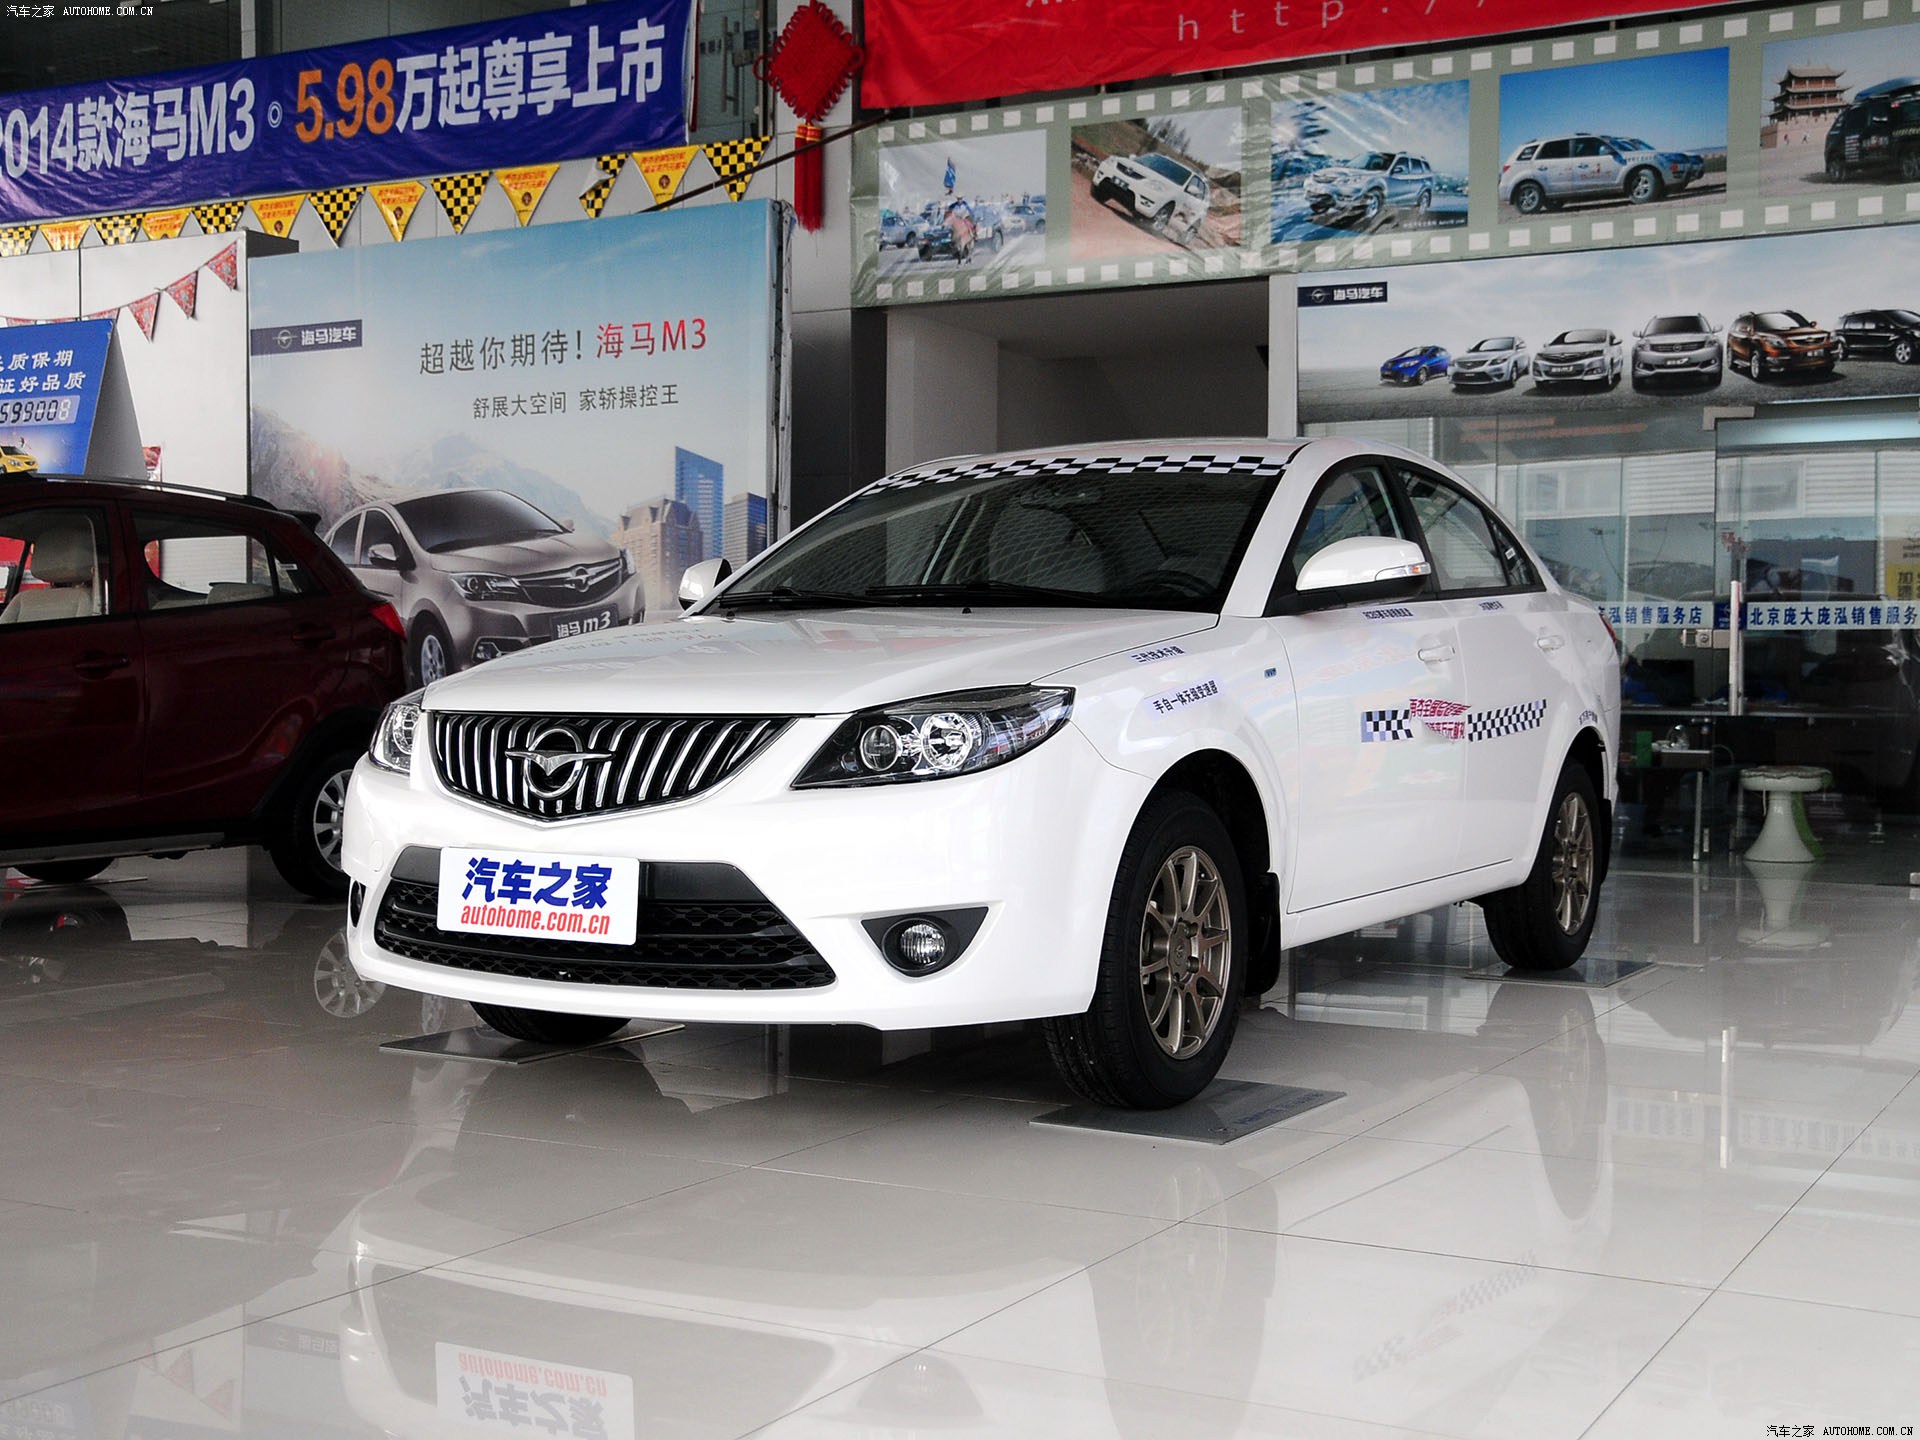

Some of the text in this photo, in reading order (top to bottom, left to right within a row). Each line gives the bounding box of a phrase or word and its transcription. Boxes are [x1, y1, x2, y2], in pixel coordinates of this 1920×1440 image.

[296, 18, 666, 143] 5.98万起尊享上市
[301, 326, 357, 346] 海马汽车
[473, 384, 679, 419] 舒展大空间 家轿操控王
[1749, 605, 1918, 626] 北京庞大庞泓销售服务
[1152, 680, 1219, 714] 手自一体无级变速器
[462, 857, 612, 909] 汽车之家
[460, 904, 610, 935] autohome.com.cn
